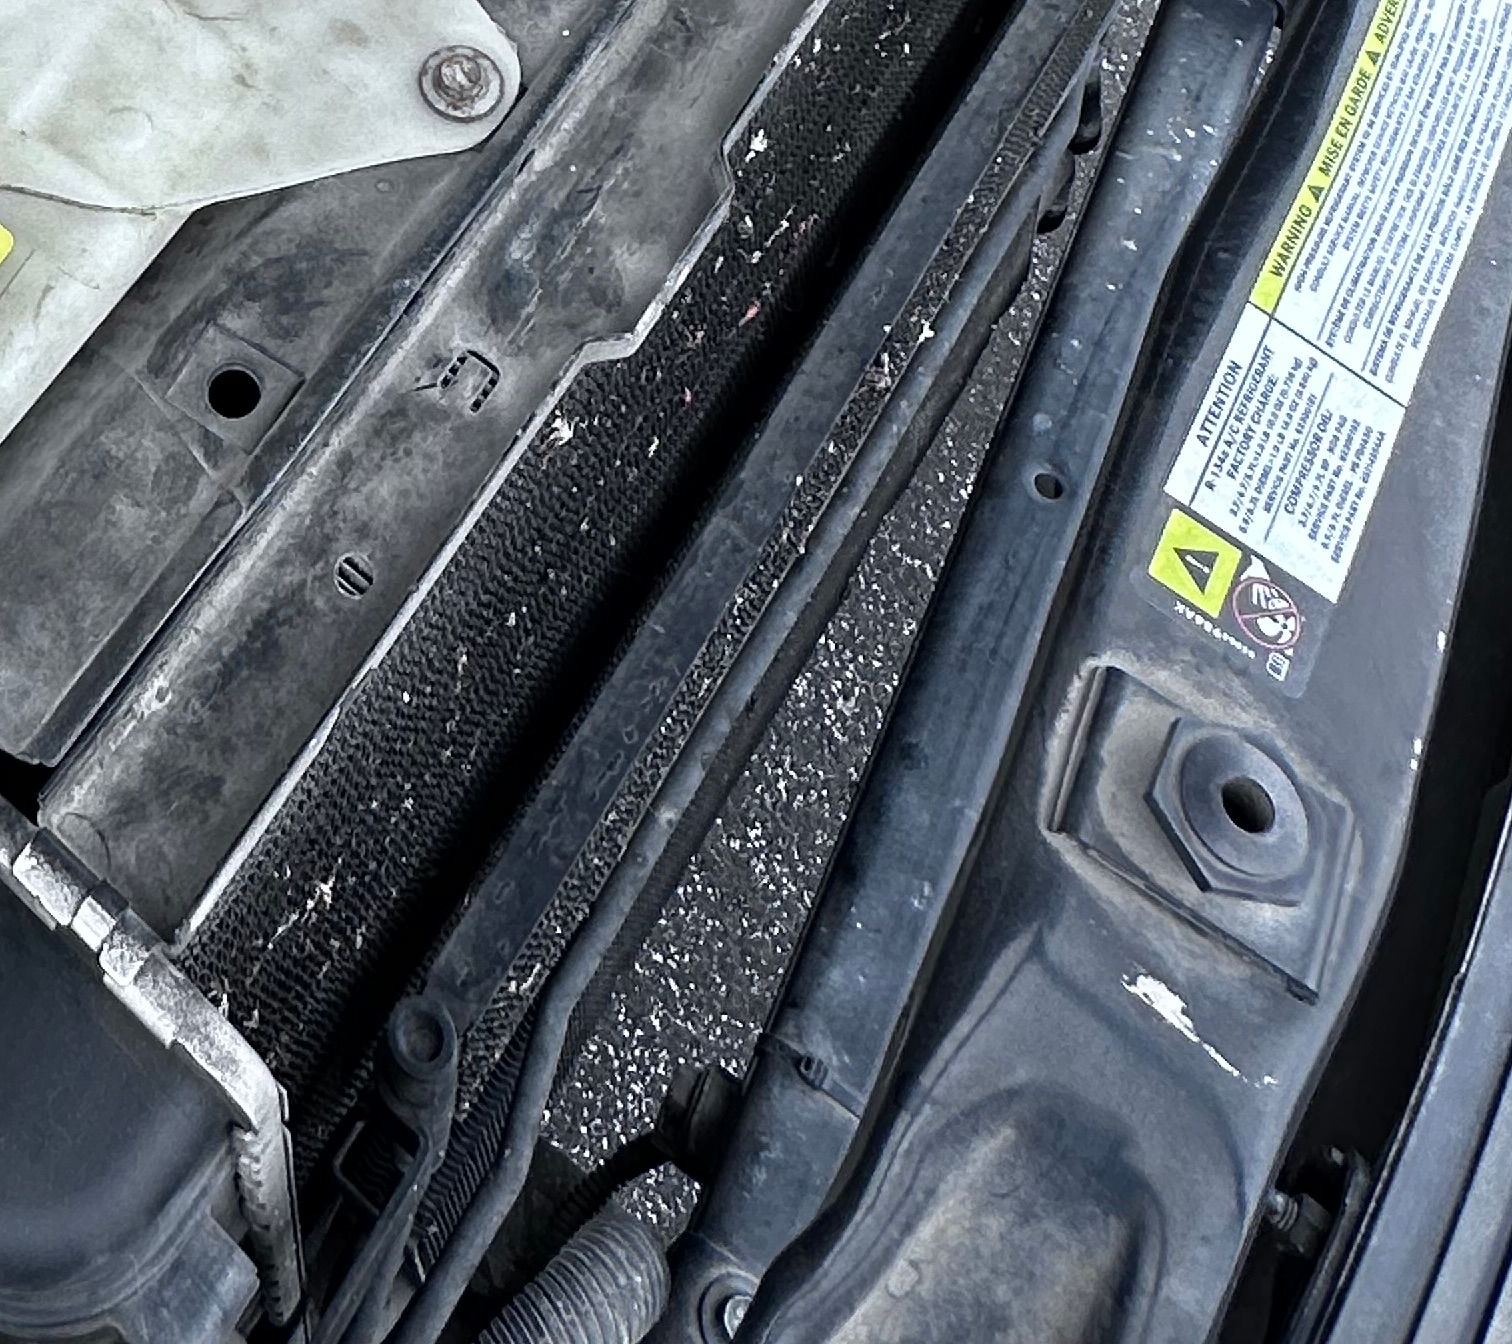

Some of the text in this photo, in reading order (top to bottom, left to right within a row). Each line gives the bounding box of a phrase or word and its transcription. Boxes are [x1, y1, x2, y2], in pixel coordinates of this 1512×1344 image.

[1267, 202, 1313, 277] WARNING
[1316, 137, 1344, 177] MISE
[1333, 115, 1353, 138] EN
[1343, 66, 1372, 117] GARDE
[1192, 358, 1243, 446] ATTENTION
